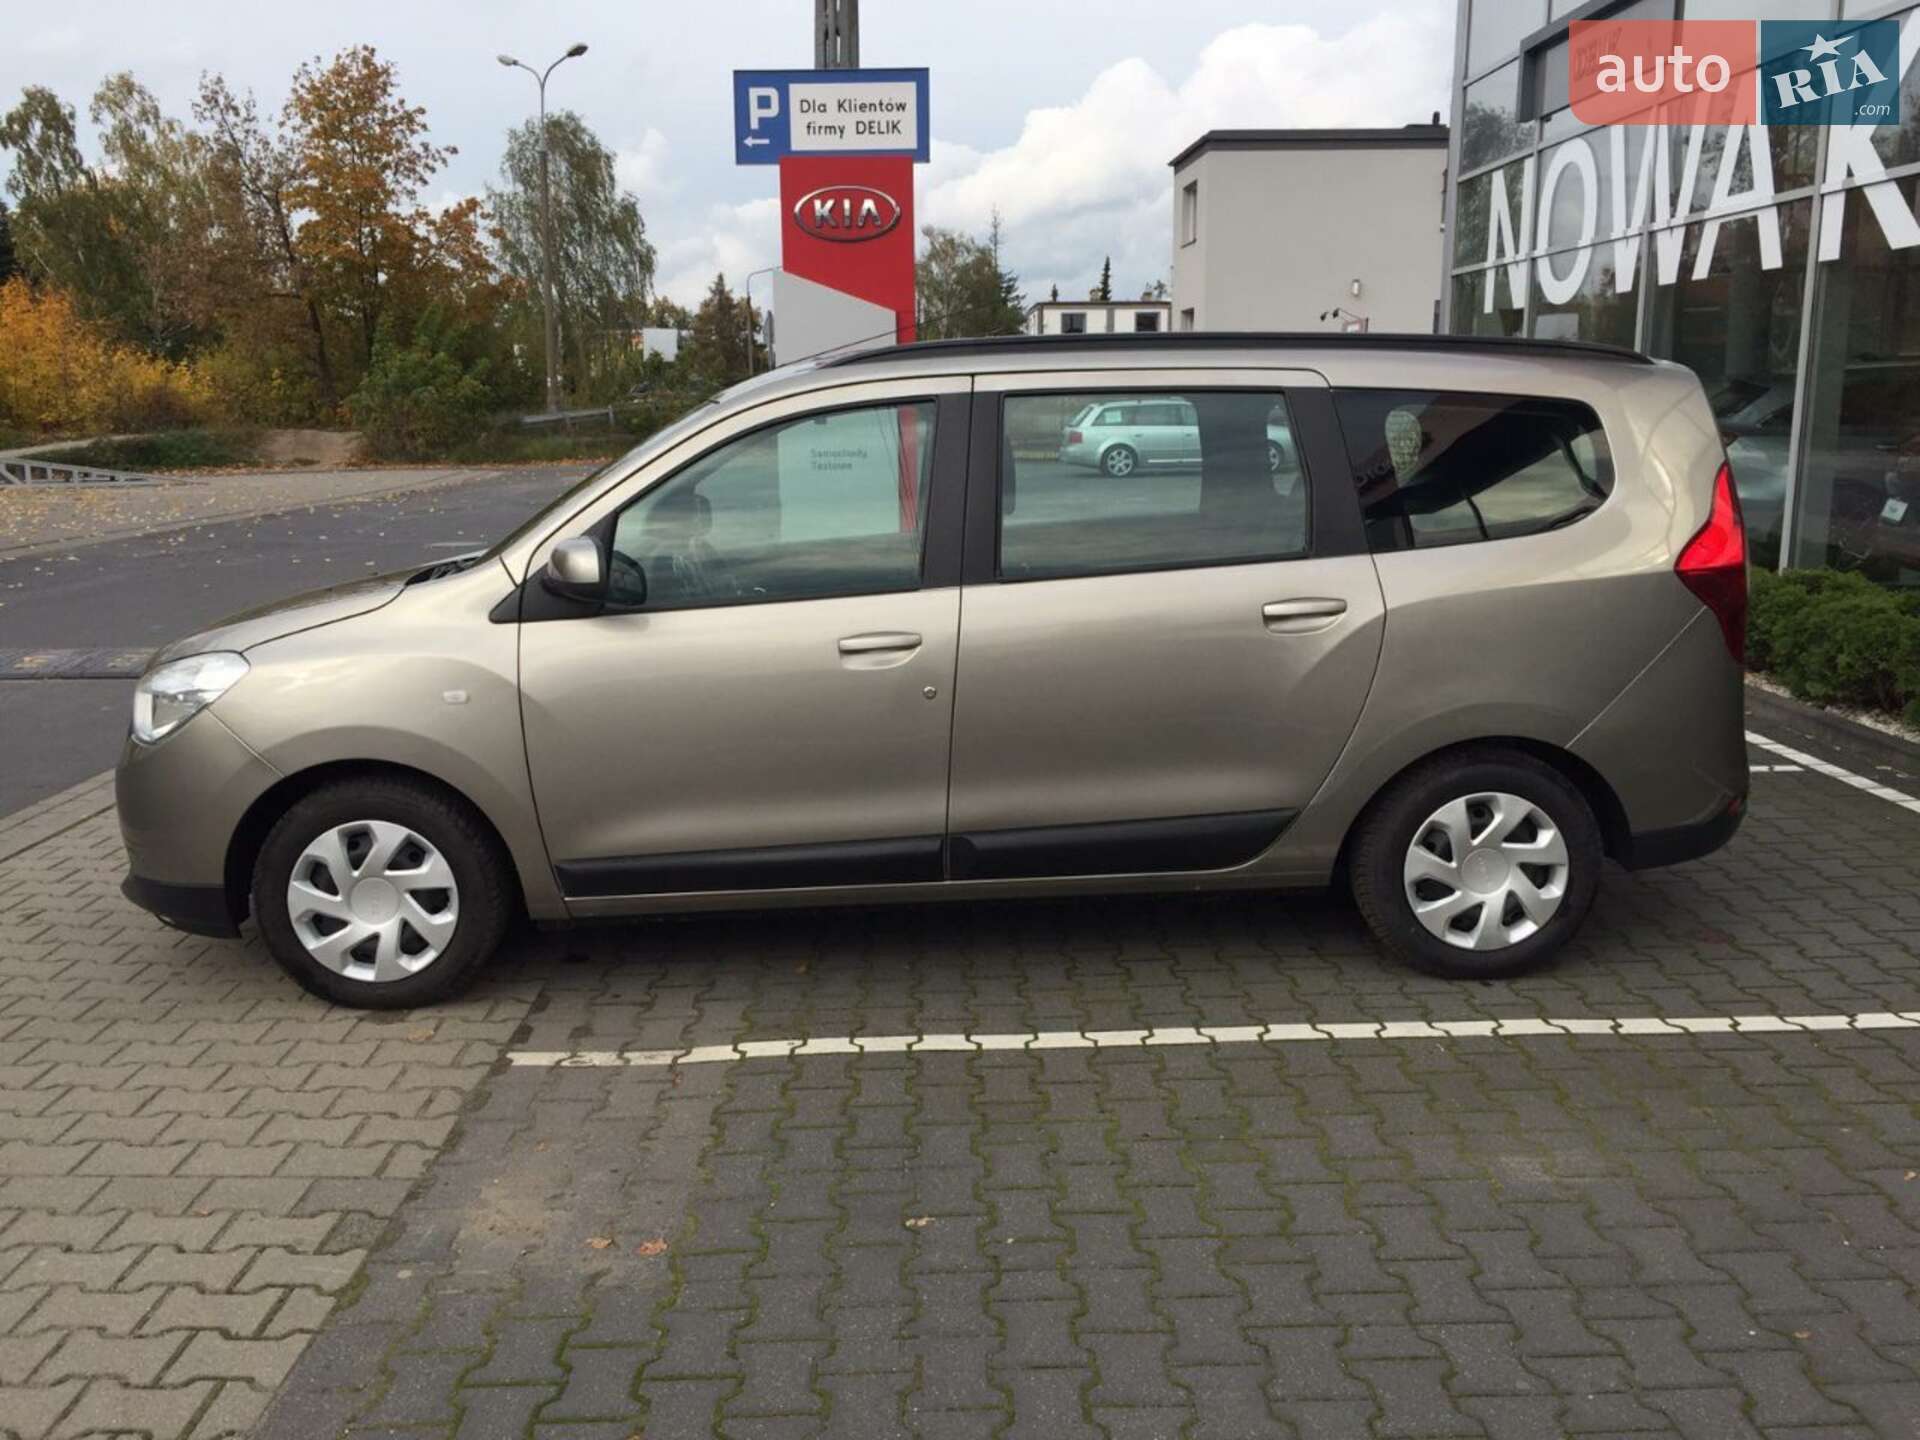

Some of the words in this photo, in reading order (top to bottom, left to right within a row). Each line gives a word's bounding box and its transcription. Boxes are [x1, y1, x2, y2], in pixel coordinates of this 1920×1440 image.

[749, 87, 779, 129] P
[799, 99, 827, 114] Dla
[837, 97, 907, 113] Klientów
[806, 121, 845, 139] firmy
[855, 120, 901, 135] DELIK
[813, 198, 882, 229] KIA
